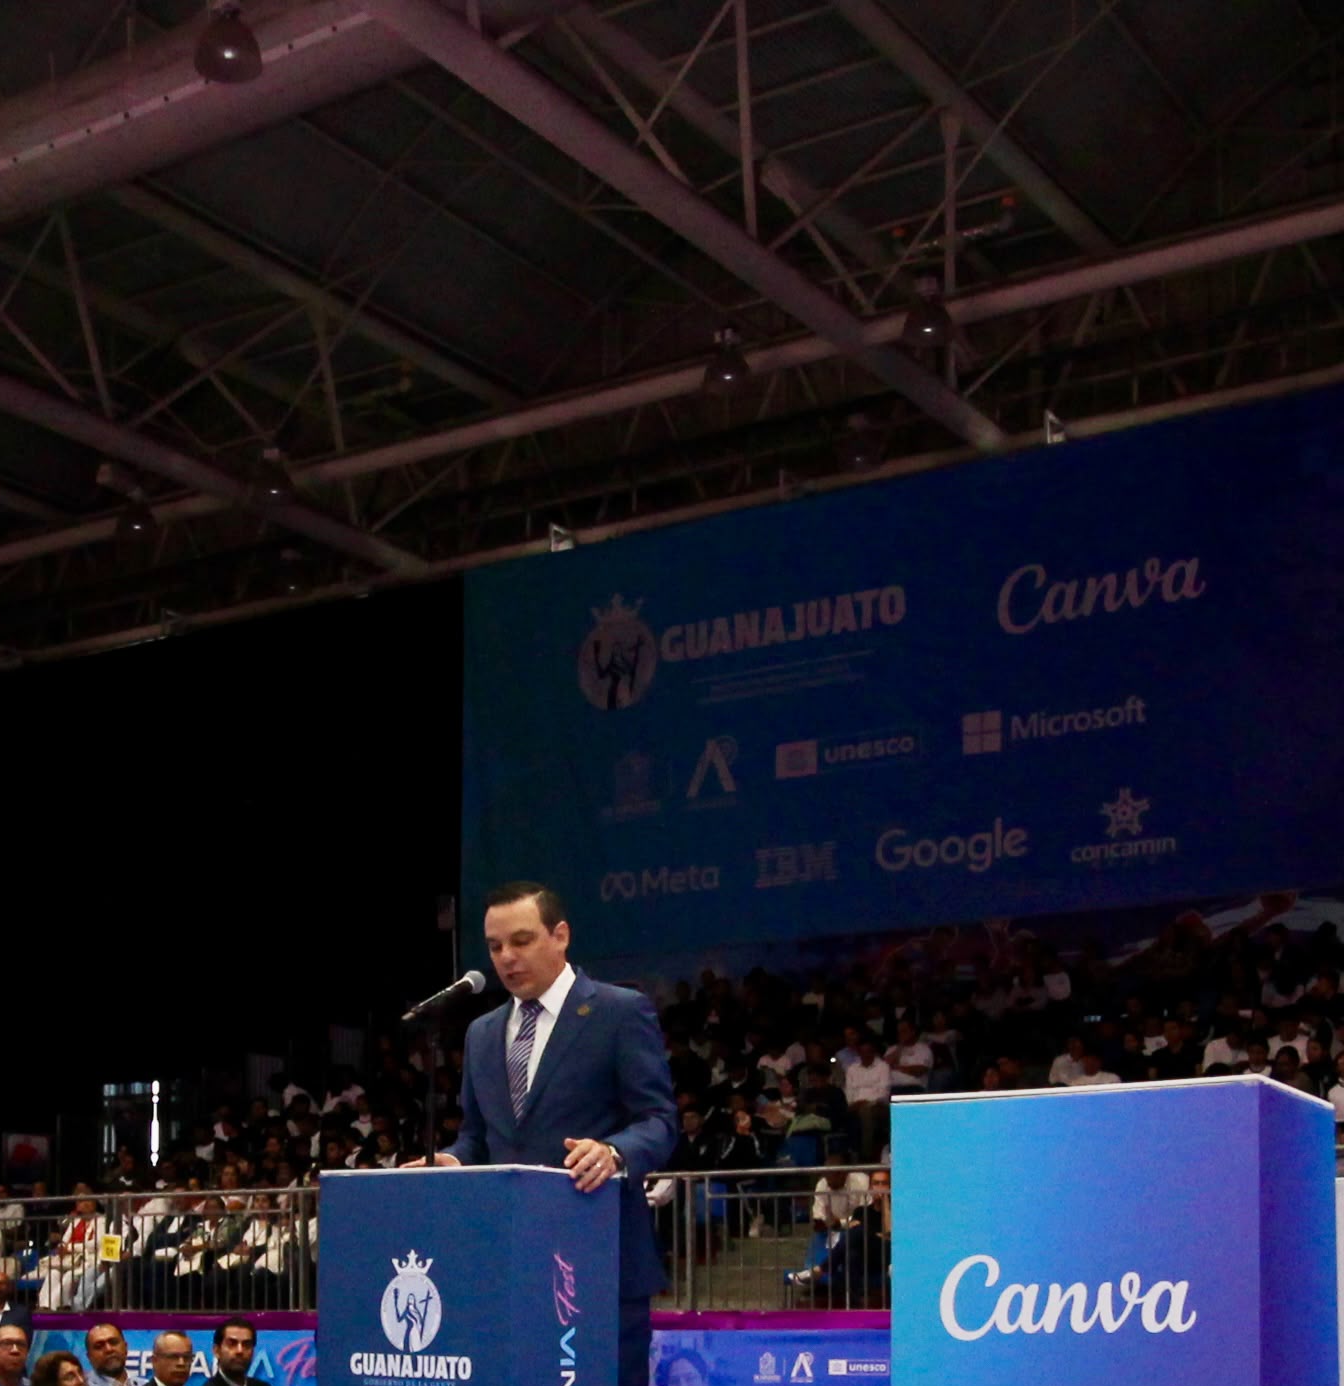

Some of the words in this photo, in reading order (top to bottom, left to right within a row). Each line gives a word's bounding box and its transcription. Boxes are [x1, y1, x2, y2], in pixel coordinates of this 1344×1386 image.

[996, 556, 1207, 636] Canva
[659, 584, 908, 662] GUANAJUATO
[1011, 697, 1147, 742] Microsoft
[824, 734, 916, 765] unesco
[754, 842, 840, 889] IBM
[875, 817, 1029, 874] Google
[1070, 834, 1178, 865] concamin
[640, 864, 720, 896] Meta
[939, 1254, 1197, 1341] Canva
[350, 1352, 472, 1381] GUANAJUATO
[848, 1362, 887, 1373] unesco
